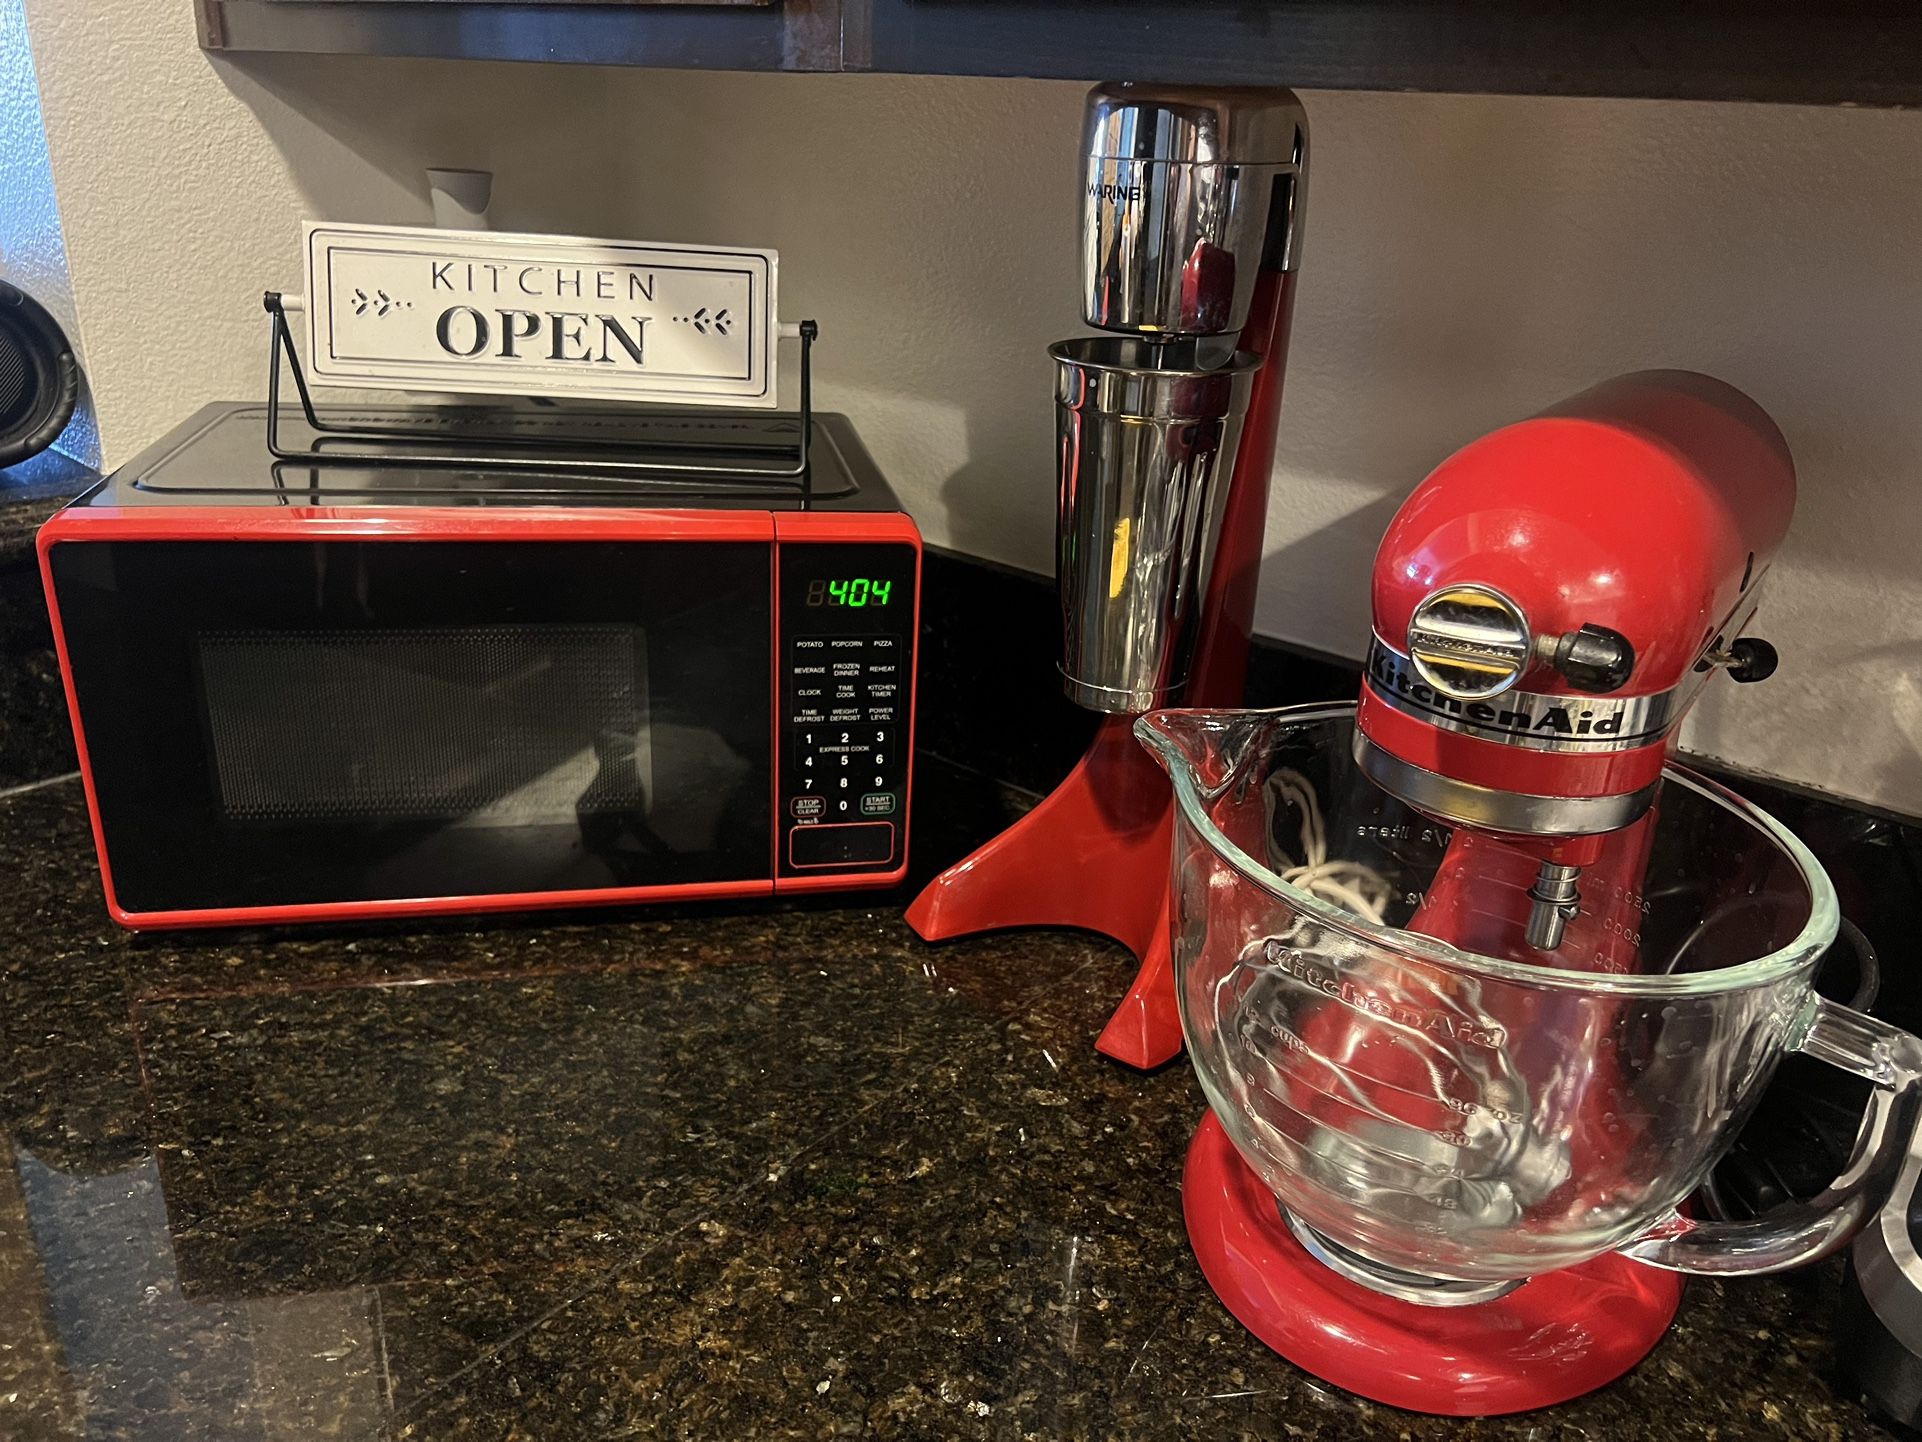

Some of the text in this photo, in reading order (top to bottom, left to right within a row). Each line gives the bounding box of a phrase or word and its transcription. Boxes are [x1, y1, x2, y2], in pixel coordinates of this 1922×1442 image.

[431, 261, 655, 301] KITCHEN
[435, 305, 654, 367] OPEN
[829, 579, 891, 606] 404
[1371, 652, 1624, 735] KitchenAid
[793, 715, 825, 723] DEFROST
[805, 733, 812, 744] 1
[841, 732, 849, 743] 2
[876, 731, 884, 742] 3
[805, 756, 813, 767] 4
[841, 755, 848, 765] 5
[876, 754, 884, 764] 6
[805, 779, 813, 789] 7
[840, 777, 848, 788] 8
[875, 776, 883, 787] 9
[839, 800, 848, 811] 0
